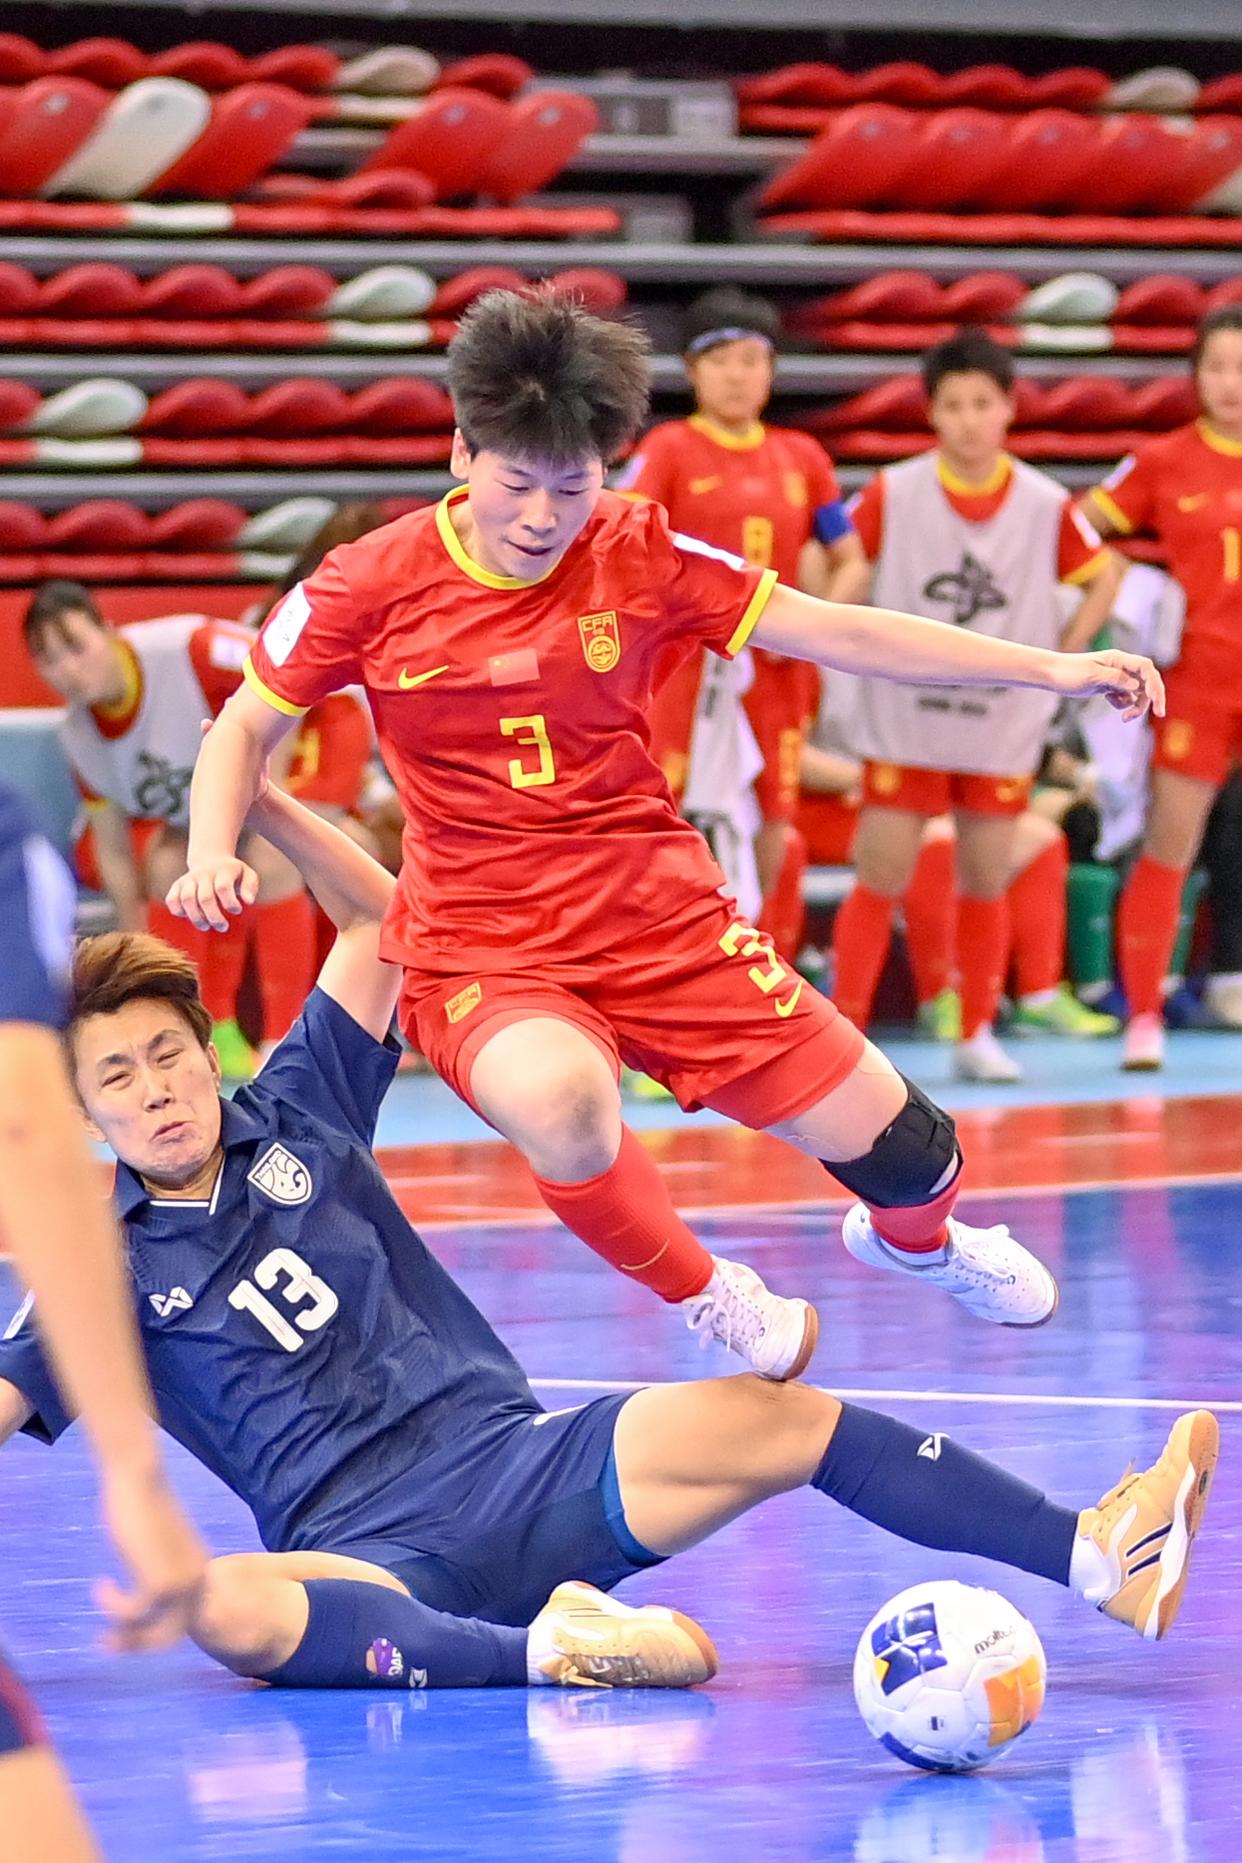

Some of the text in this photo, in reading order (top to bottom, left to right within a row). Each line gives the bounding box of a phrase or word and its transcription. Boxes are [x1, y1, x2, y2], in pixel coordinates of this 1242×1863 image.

[582, 615, 613, 632] CFA
[499, 714, 556, 789] 3
[717, 922, 787, 993] 3
[227, 1247, 339, 1352] 13
